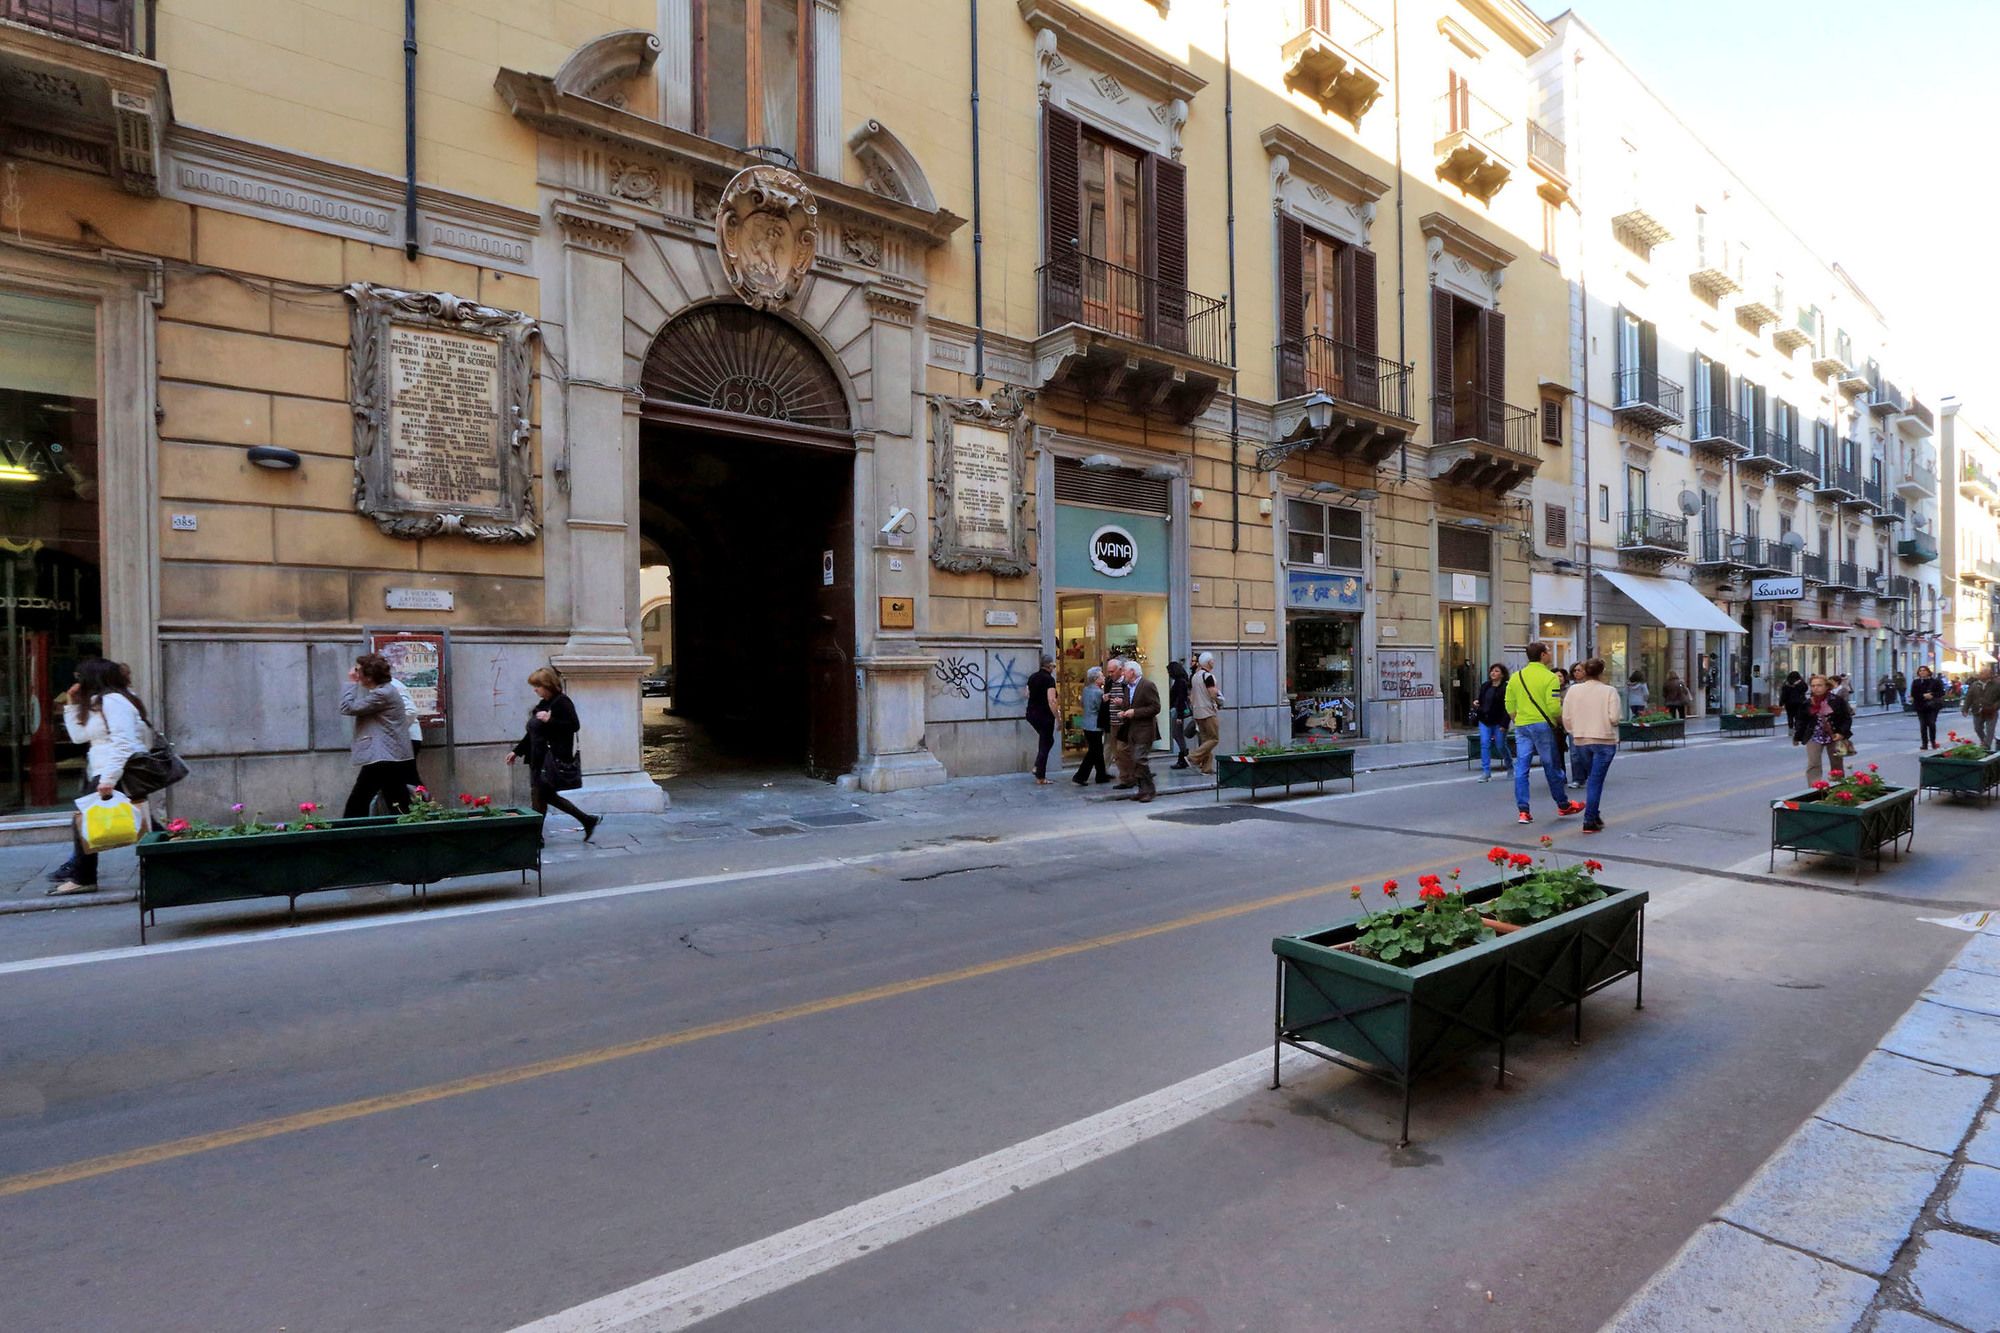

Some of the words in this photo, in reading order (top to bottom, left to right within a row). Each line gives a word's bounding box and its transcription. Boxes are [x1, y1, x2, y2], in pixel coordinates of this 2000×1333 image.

[390, 344, 418, 356] PIETRO
[421, 349, 443, 360] LANZA
[466, 356, 496, 368] SCORDIA
[391, 400, 427, 411] ECONOMISTA
[1754, 583, 1798, 596] Laurino
